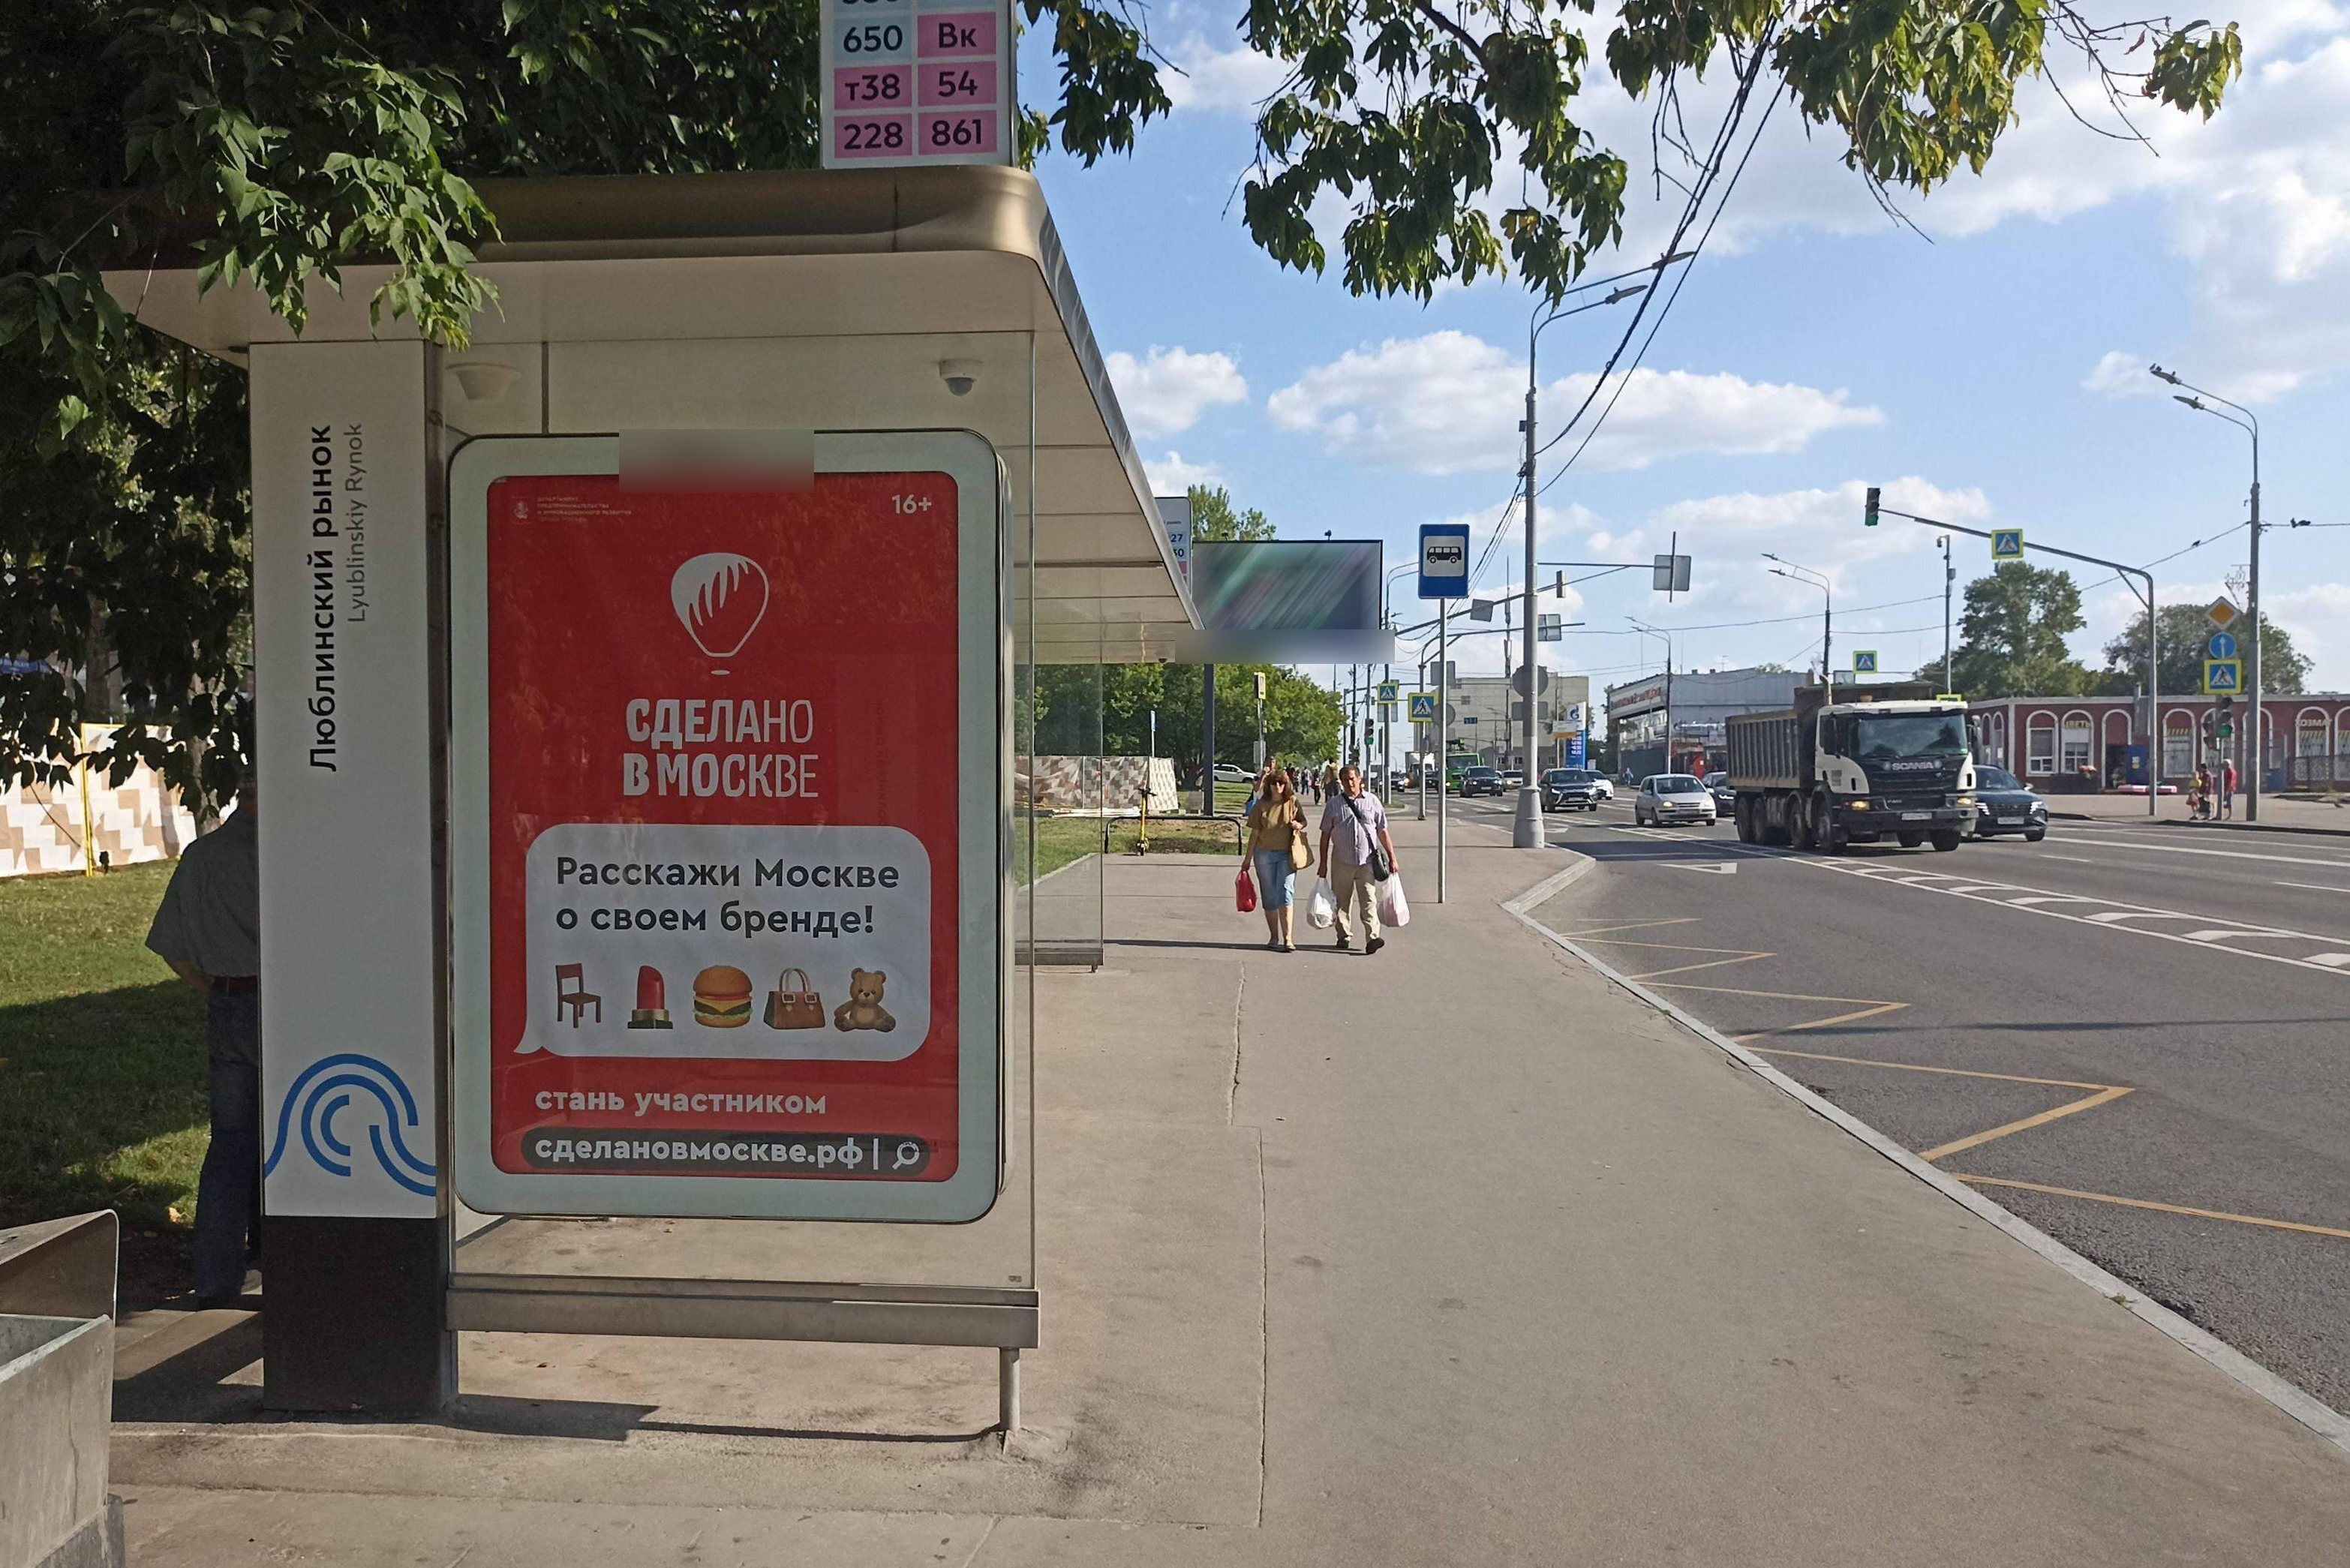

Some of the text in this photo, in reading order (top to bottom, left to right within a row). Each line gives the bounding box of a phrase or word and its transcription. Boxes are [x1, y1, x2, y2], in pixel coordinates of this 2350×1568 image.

[843, 25, 903, 53] 650
[939, 23, 977, 49] Вк
[845, 73, 900, 102] т38
[938, 71, 978, 98] 54
[843, 122, 903, 150] 228
[931, 119, 981, 146] 861
[891, 494, 932, 515] 16+
[343, 422, 369, 623] Lyublinskiy Rynok
[308, 425, 338, 772] Люблинский рынок
[625, 698, 813, 749] СДЕЛАНО
[622, 752, 819, 798] В МОСКВЕ
[1892, 761, 1934, 771] SCANIA
[556, 856, 900, 889] Расскажи Москве
[556, 901, 874, 939] о своем бренде!
[535, 1091, 826, 1116] стань участником
[535, 1137, 864, 1169] сделановмоскве.рф
